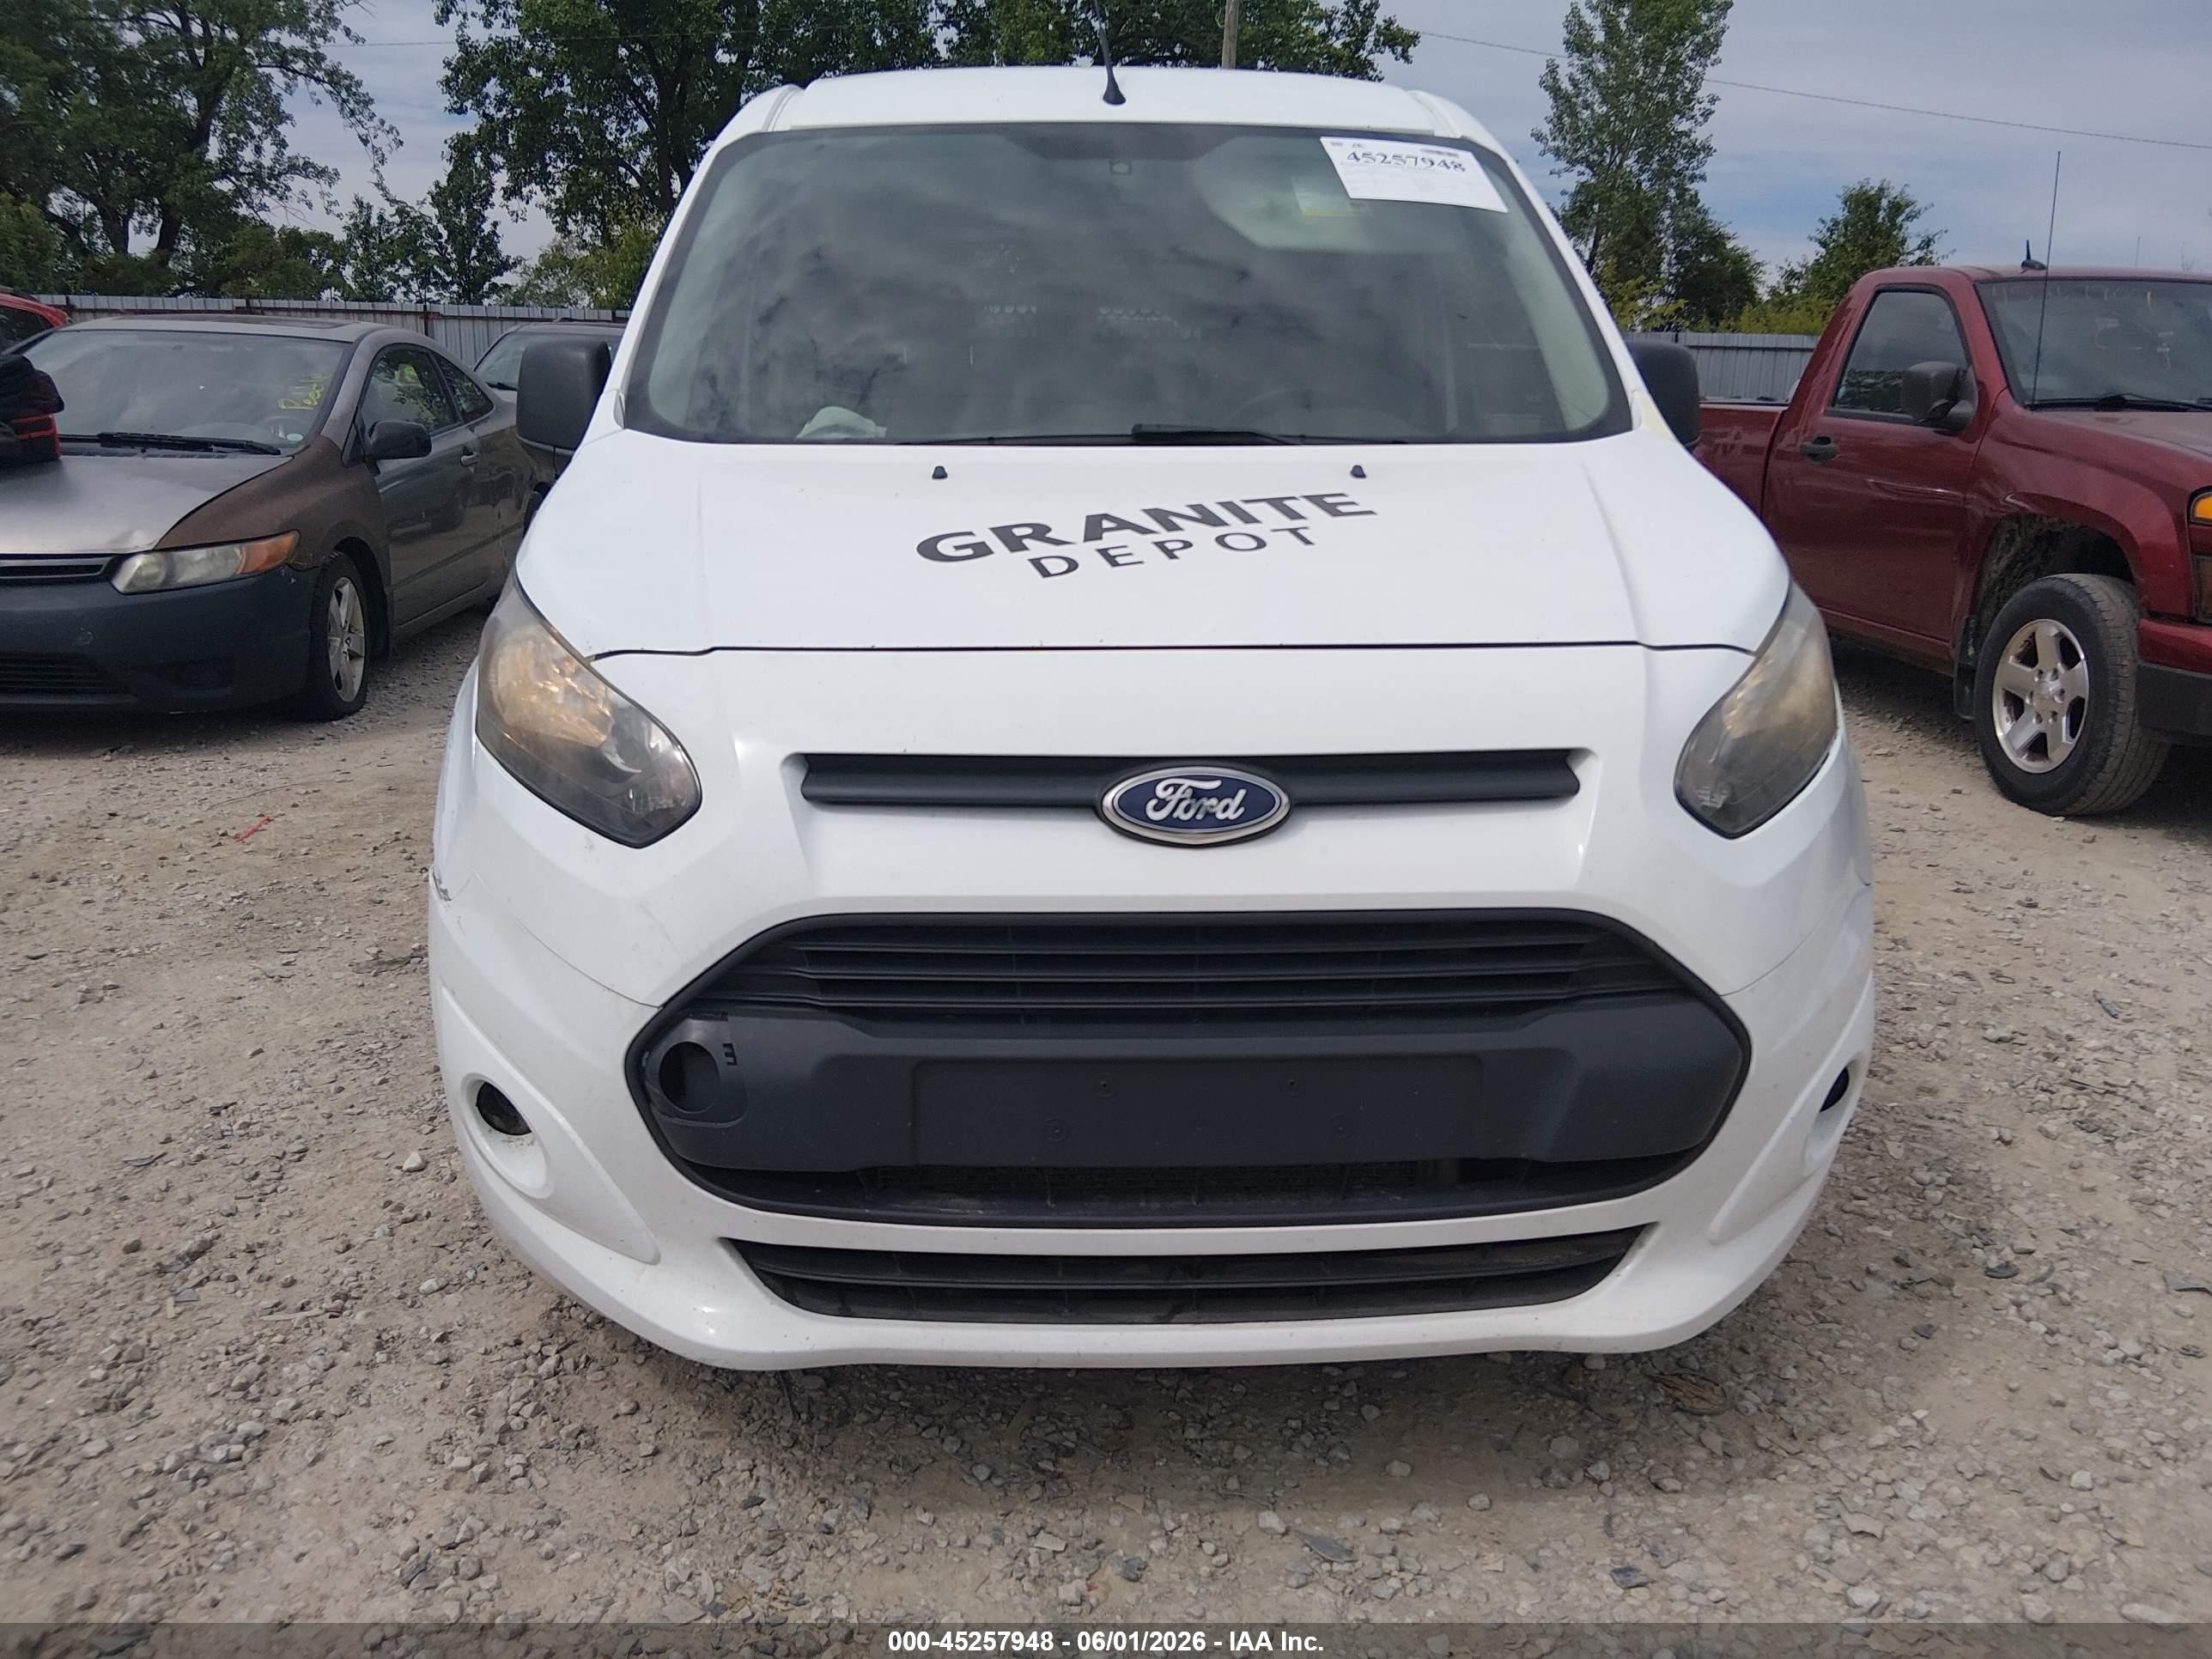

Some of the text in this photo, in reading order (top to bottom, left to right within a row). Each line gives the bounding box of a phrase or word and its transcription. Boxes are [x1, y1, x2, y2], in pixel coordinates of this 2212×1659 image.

[1346, 151, 1466, 172] 45257948
[916, 493, 1377, 562] GRANITE
[1027, 526, 1315, 579] DEPOT
[1146, 777, 1248, 821] Ford
